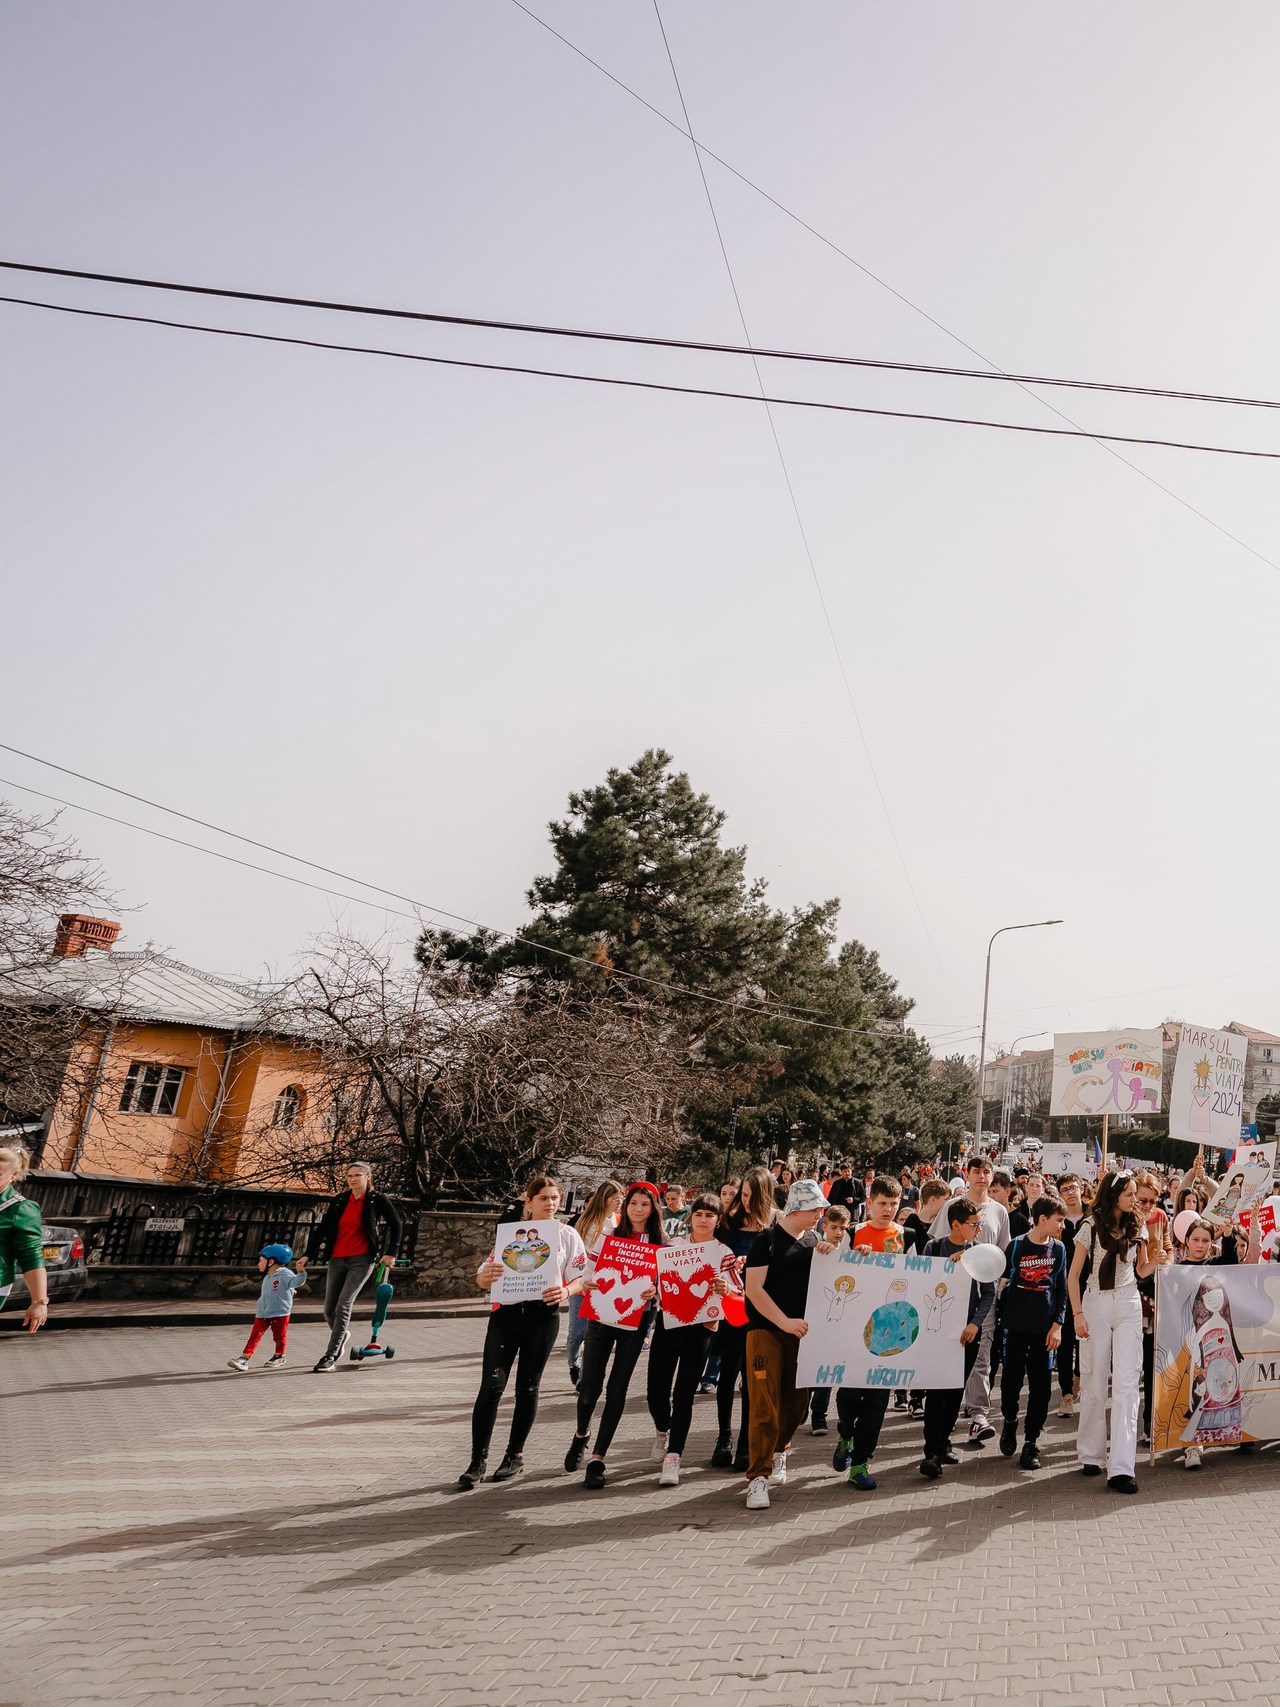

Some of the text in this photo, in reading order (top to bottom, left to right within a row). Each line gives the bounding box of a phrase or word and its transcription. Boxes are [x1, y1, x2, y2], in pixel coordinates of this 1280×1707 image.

[1216, 1055, 1245, 1074] PENTRU
[1211, 1091, 1241, 1117] 2024
[609, 1240, 654, 1254] EGALITATEA
[617, 1248, 645, 1259] ÎNCEPE
[664, 1246, 705, 1259] IUBEȘTE
[603, 1253, 656, 1270] LA CONCEPȚIE
[672, 1256, 702, 1267] VIAȚA
